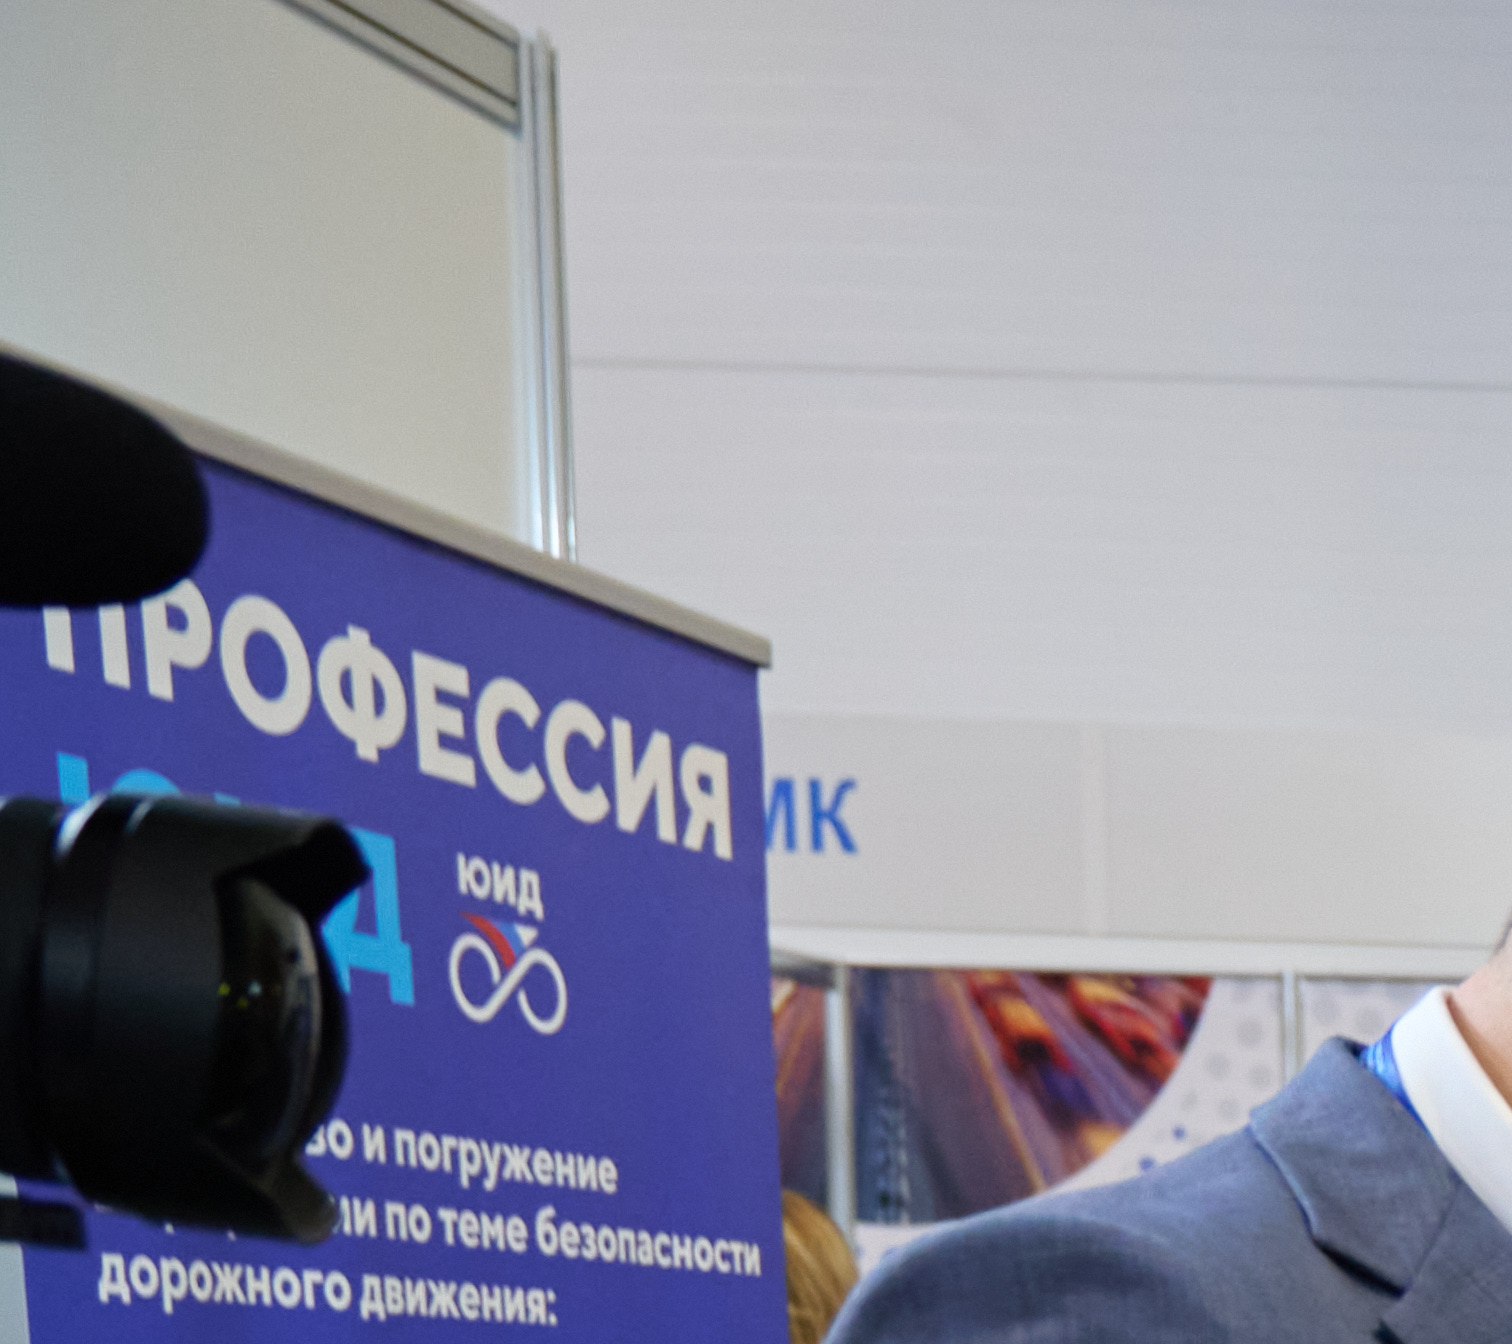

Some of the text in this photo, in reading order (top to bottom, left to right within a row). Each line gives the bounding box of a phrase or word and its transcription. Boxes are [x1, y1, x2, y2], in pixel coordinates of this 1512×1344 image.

[456, 852, 544, 920] ЮИД
[362, 1123, 386, 1164] и
[394, 1128, 618, 1195] погружение
[385, 1201, 432, 1244] по
[437, 1206, 529, 1252] теме
[535, 1207, 761, 1276] безопасности
[98, 1251, 558, 1327] дорожного движения:
